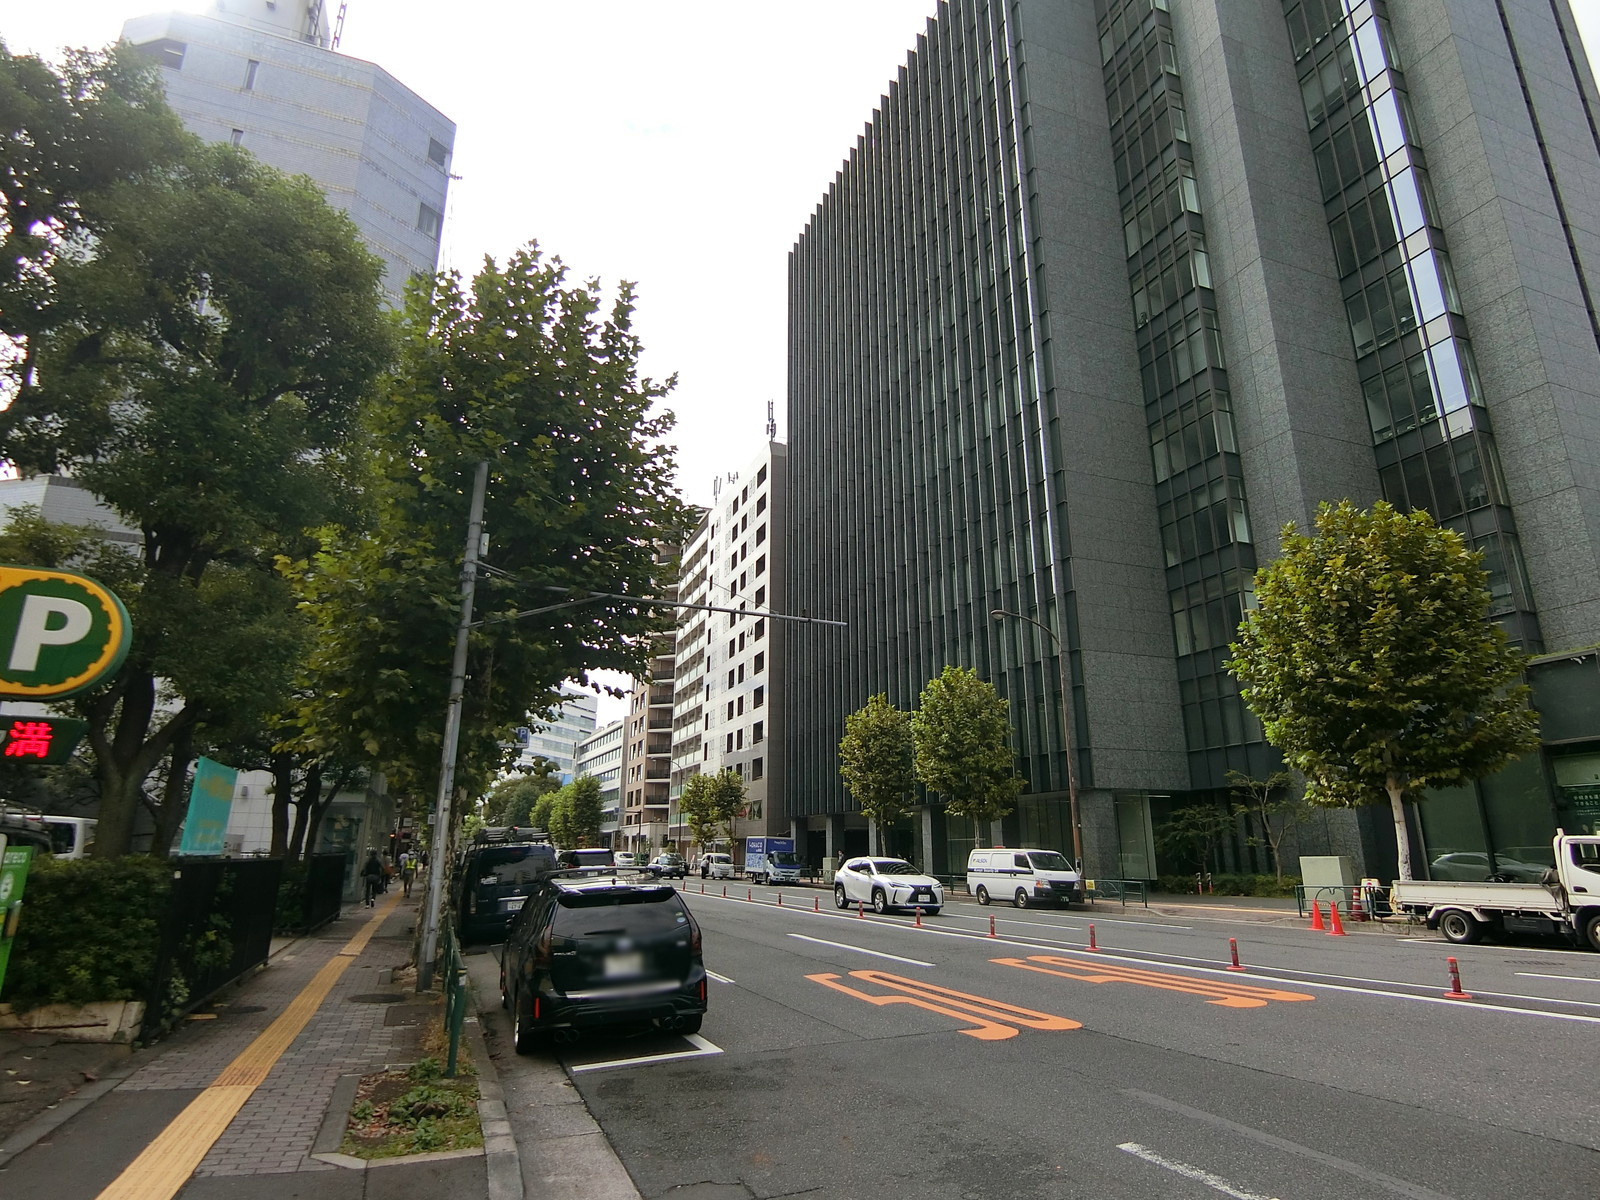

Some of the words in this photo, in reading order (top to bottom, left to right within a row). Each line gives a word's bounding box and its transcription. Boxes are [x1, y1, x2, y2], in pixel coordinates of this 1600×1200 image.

[8, 594, 92, 672] P
[4, 721, 53, 759] 満
[804, 969, 1083, 1040] 50
[988, 956, 1316, 1008] 50
